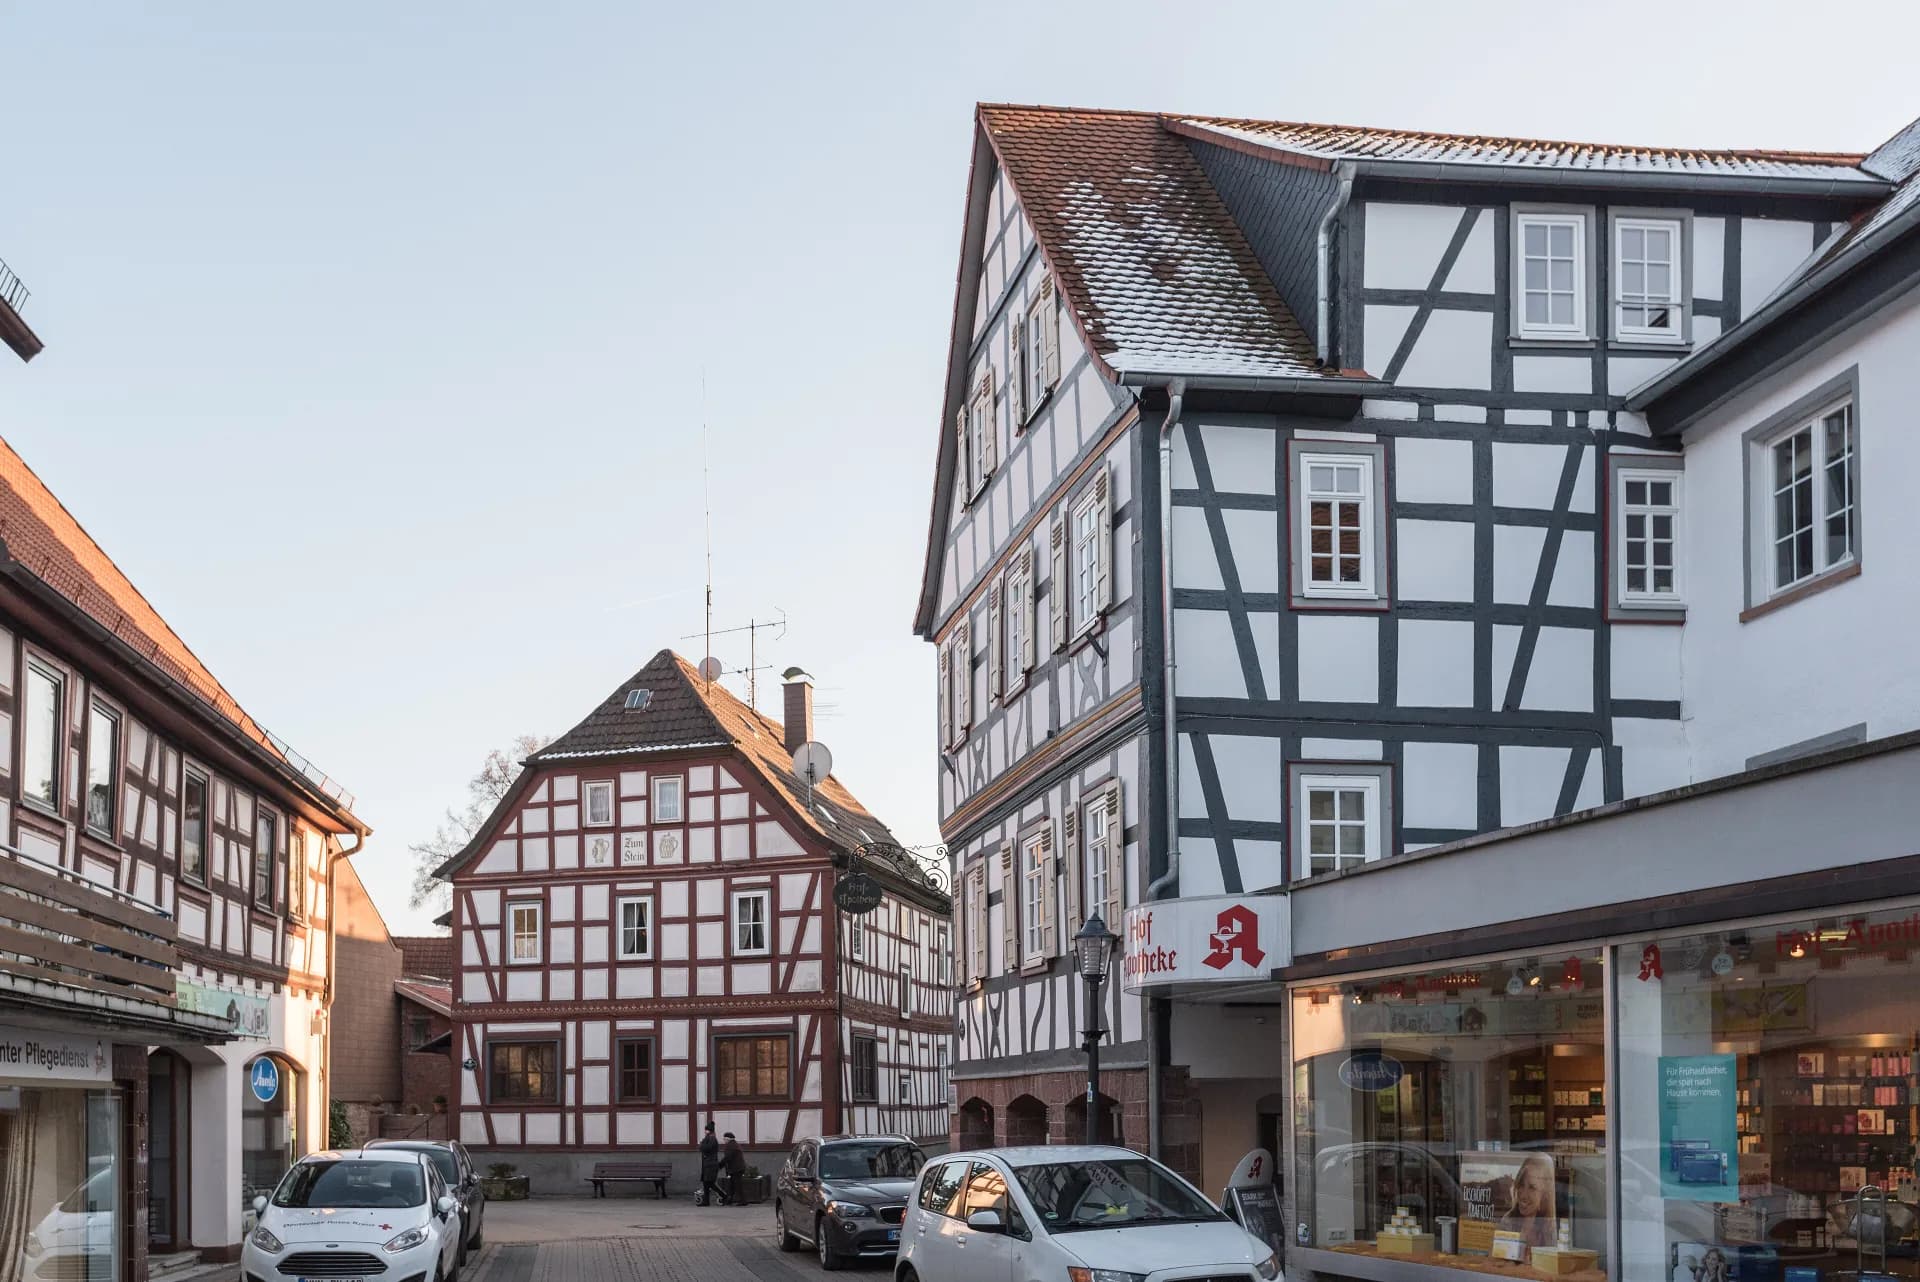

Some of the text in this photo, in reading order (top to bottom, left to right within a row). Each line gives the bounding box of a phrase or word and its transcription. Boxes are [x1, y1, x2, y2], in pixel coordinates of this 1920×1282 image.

[624, 836, 644, 849] Zum
[624, 850, 645, 862] Stein
[1129, 911, 1153, 946] Hof
[25, 1040, 89, 1070] Pflegedienst
[1666, 1066, 1678, 1076] Für
[1678, 1078, 1694, 1088] spät
[1694, 1077, 1712, 1087] nach
